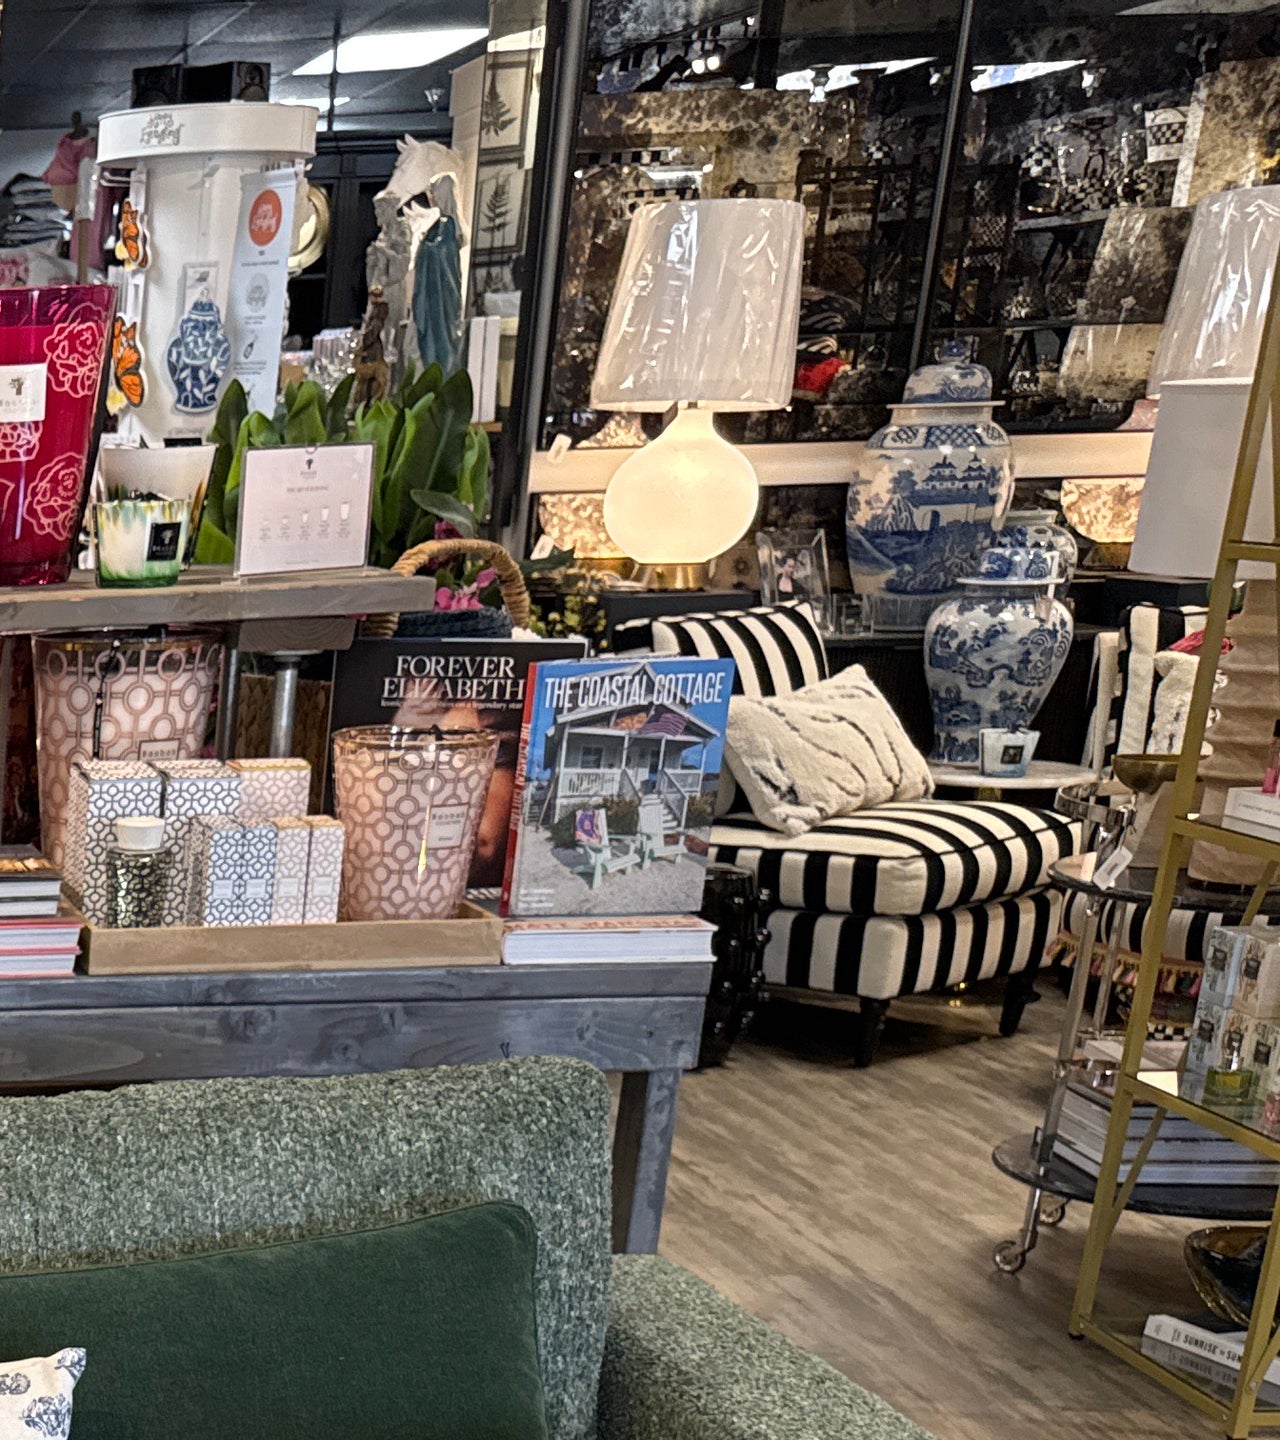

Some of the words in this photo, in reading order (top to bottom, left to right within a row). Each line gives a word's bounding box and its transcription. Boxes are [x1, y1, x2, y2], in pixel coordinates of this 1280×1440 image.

[396, 655, 515, 678] FOREVER
[382, 677, 526, 701] ELIZABETH
[545, 677, 574, 709] THE
[578, 674, 649, 708] COASTAL
[653, 672, 726, 706] COTTAGE
[1183, 1334, 1219, 1356] SUNRISE
